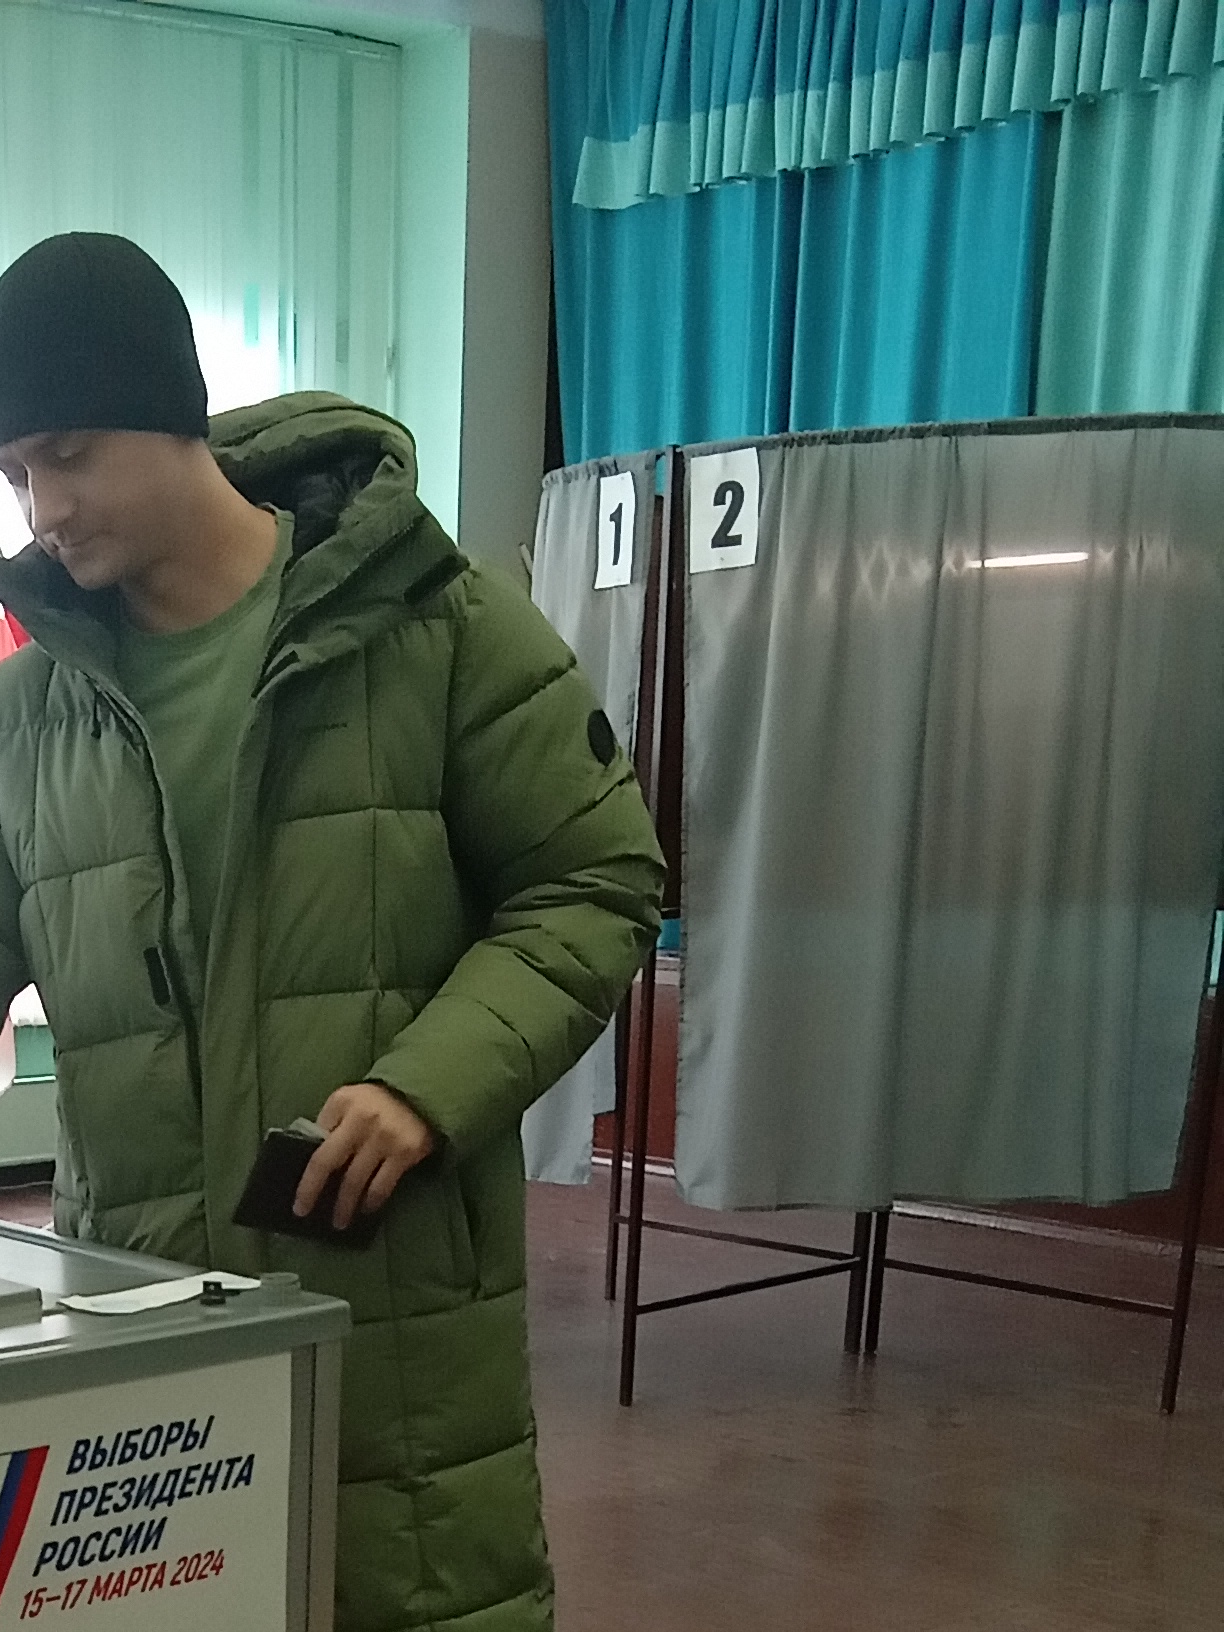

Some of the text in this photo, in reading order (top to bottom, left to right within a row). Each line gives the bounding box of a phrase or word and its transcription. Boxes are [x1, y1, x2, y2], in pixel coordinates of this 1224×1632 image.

[609, 502, 624, 566] 1
[710, 480, 745, 549] 2
[65, 1414, 216, 1475] ВЫБОРЫ
[49, 1453, 256, 1527] ПРЕЗИДЕНТА
[31, 1515, 168, 1577] РОССИИ
[87, 1560, 167, 1605] МАРТА
[169, 1548, 226, 1587] 2024
